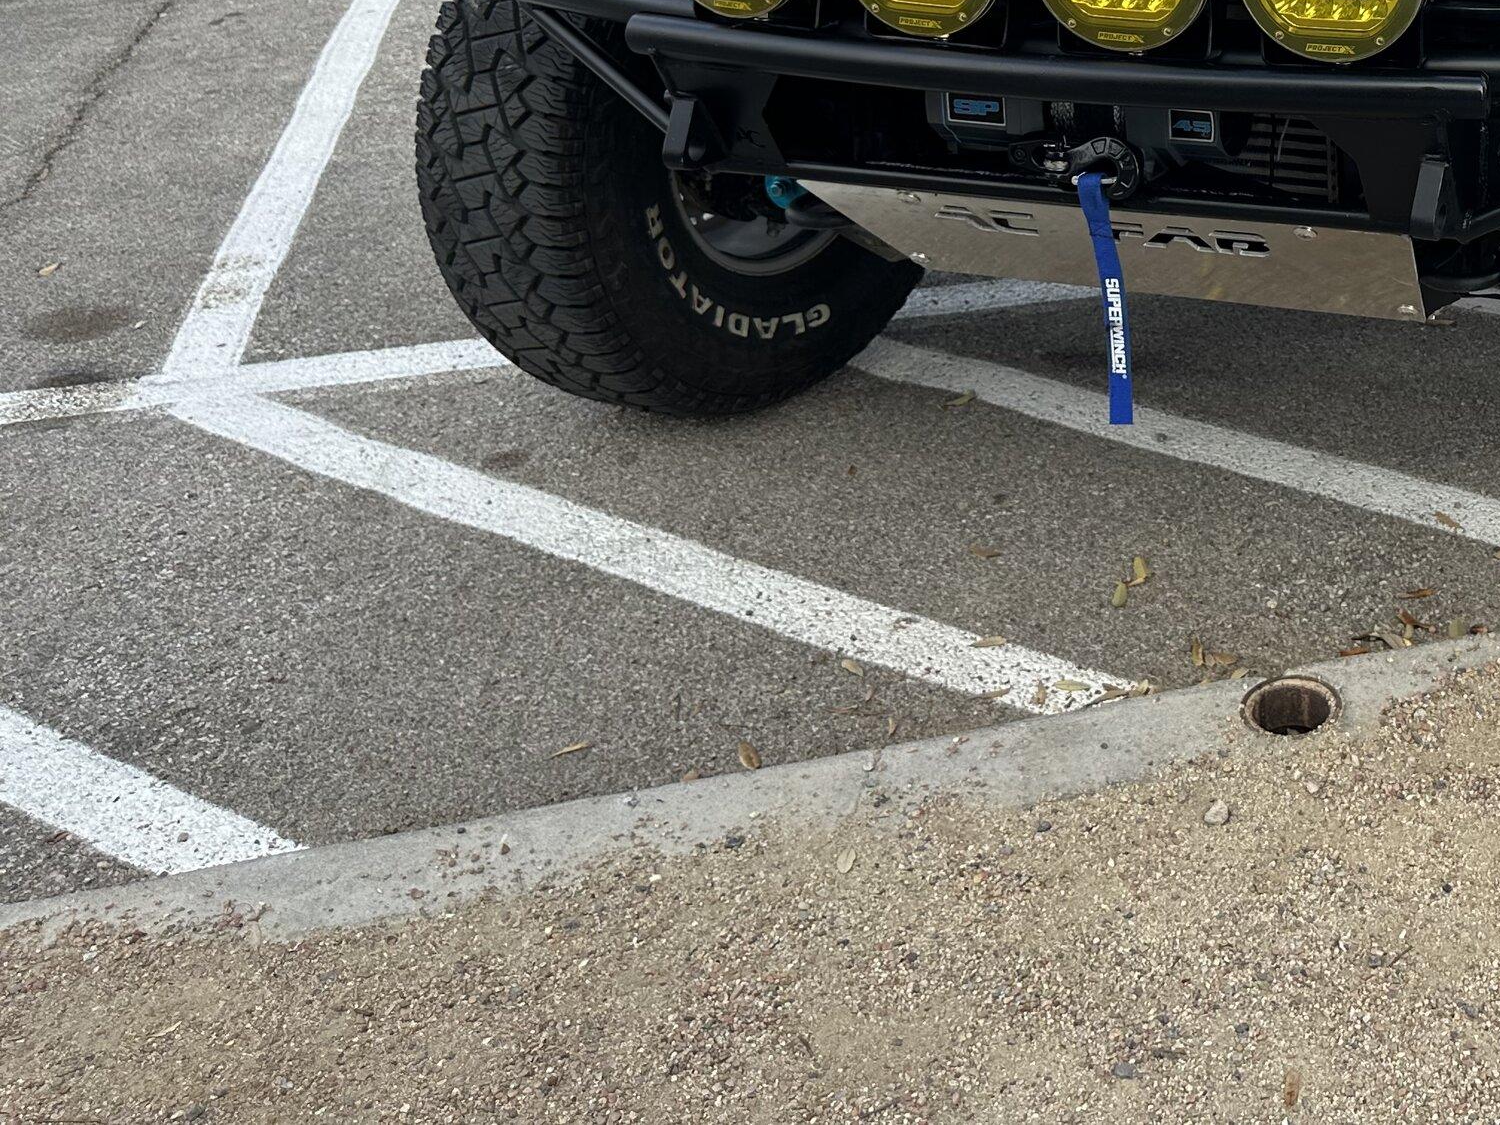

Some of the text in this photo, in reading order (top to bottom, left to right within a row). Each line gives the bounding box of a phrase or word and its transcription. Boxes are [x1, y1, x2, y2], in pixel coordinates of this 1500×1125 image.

[714, 0, 741, 10] PROJECT
[899, 17, 931, 27] PROJECT
[1098, 31, 1133, 42] PROJECT
[1306, 43, 1343, 54] PROJECT
[645, 203, 831, 339] GLADIATOR
